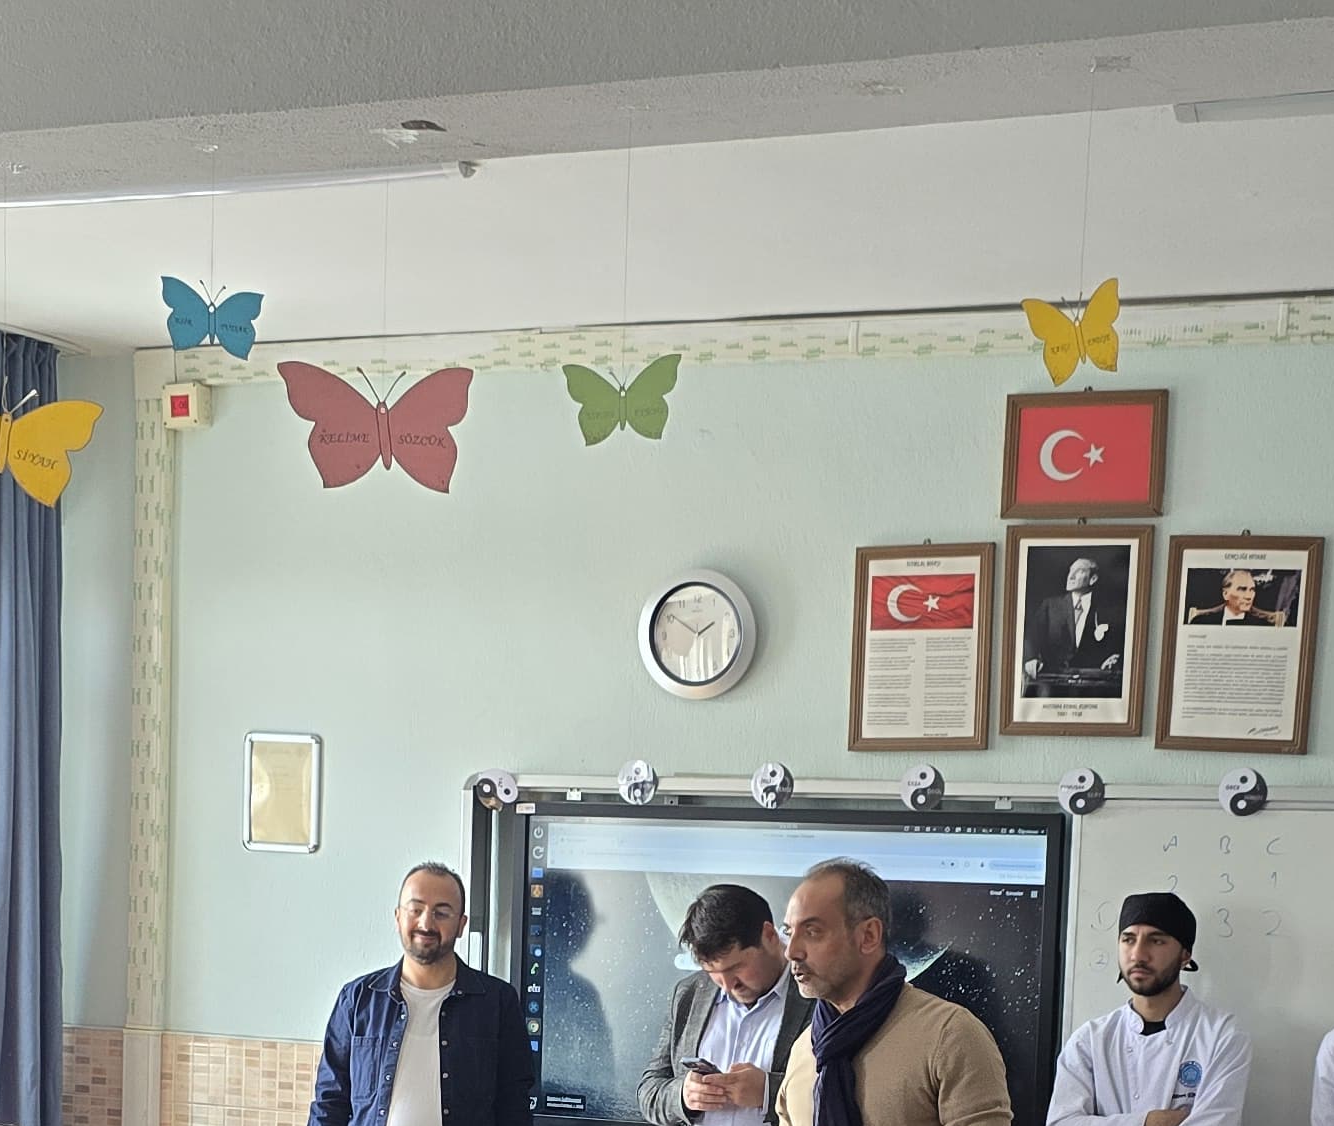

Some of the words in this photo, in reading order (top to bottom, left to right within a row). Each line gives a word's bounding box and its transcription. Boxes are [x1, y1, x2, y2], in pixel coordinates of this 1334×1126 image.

[318, 432, 370, 445] KELİME
[397, 433, 447, 448] SÖZCÜK
[14, 449, 58, 471] SİYAH
[1220, 873, 1235, 893] 3
[1217, 908, 1234, 938] 3
[1264, 910, 1290, 937] 2
